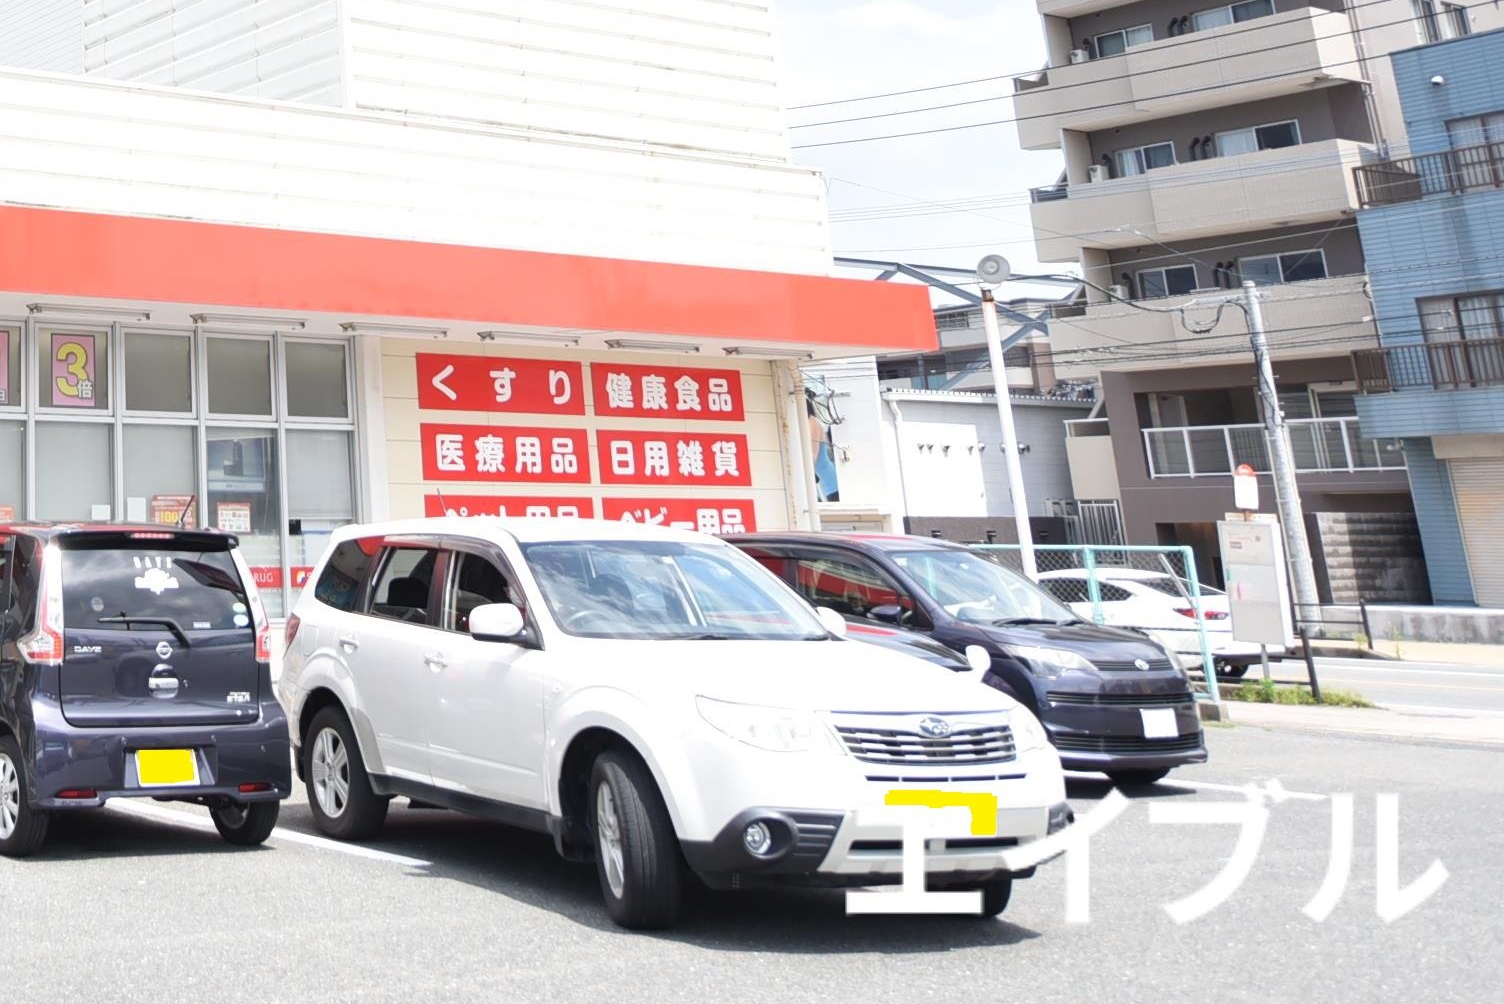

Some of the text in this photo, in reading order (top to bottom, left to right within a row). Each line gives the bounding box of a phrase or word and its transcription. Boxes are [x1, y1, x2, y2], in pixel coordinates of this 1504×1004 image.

[432, 365, 571, 405] くすり
[605, 372, 733, 411] 健康食品
[435, 434, 578, 473] 医療用品
[610, 441, 740, 477] 日用雑貨
